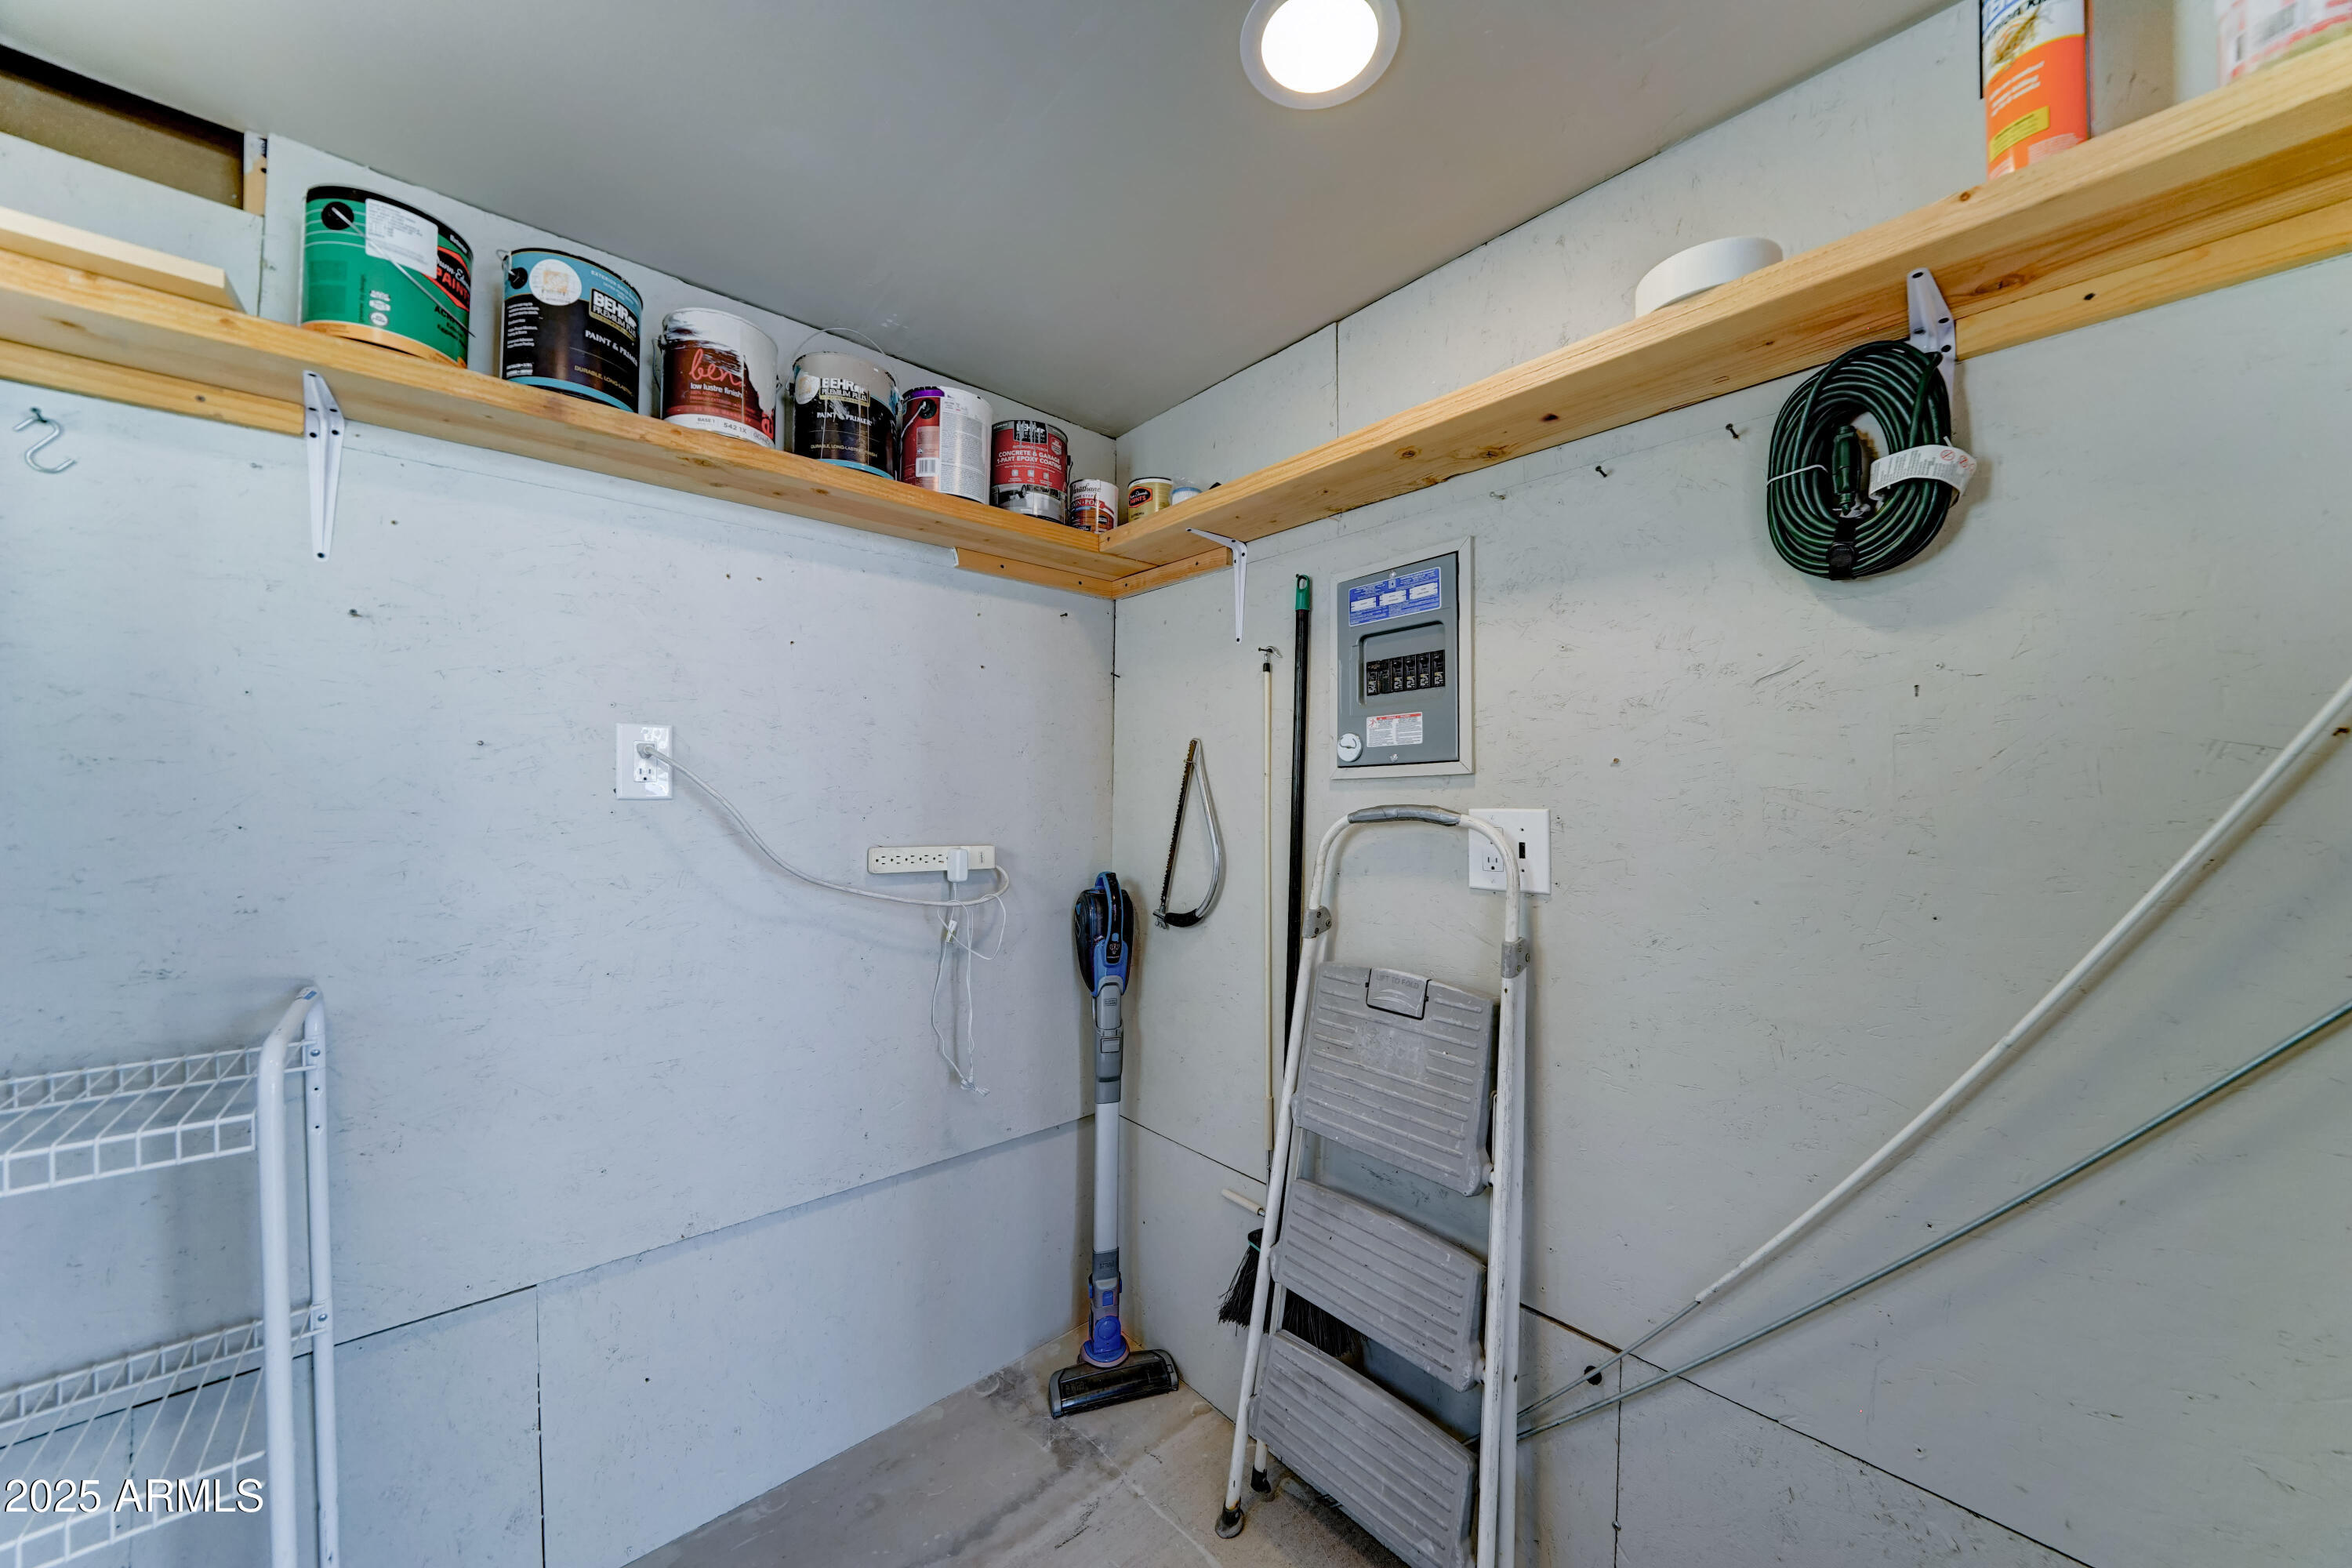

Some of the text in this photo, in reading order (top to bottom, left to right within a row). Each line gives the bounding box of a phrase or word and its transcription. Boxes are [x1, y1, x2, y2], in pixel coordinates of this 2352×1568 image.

[593, 290, 629, 323] BEHR
[585, 329, 612, 347] PAINT
[689, 348, 742, 387] ben
[690, 382, 743, 399] low lustre finish
[822, 378, 855, 391] BEHR
[723, 422, 748, 434] 542 1X
[996, 456, 1015, 464] 1-PART
[1039, 458, 1062, 470] COATING
[1039, 452, 1061, 464] GARAGE
[1376, 973, 1390, 982] LIFT
[1401, 978, 1419, 989] FOLD
